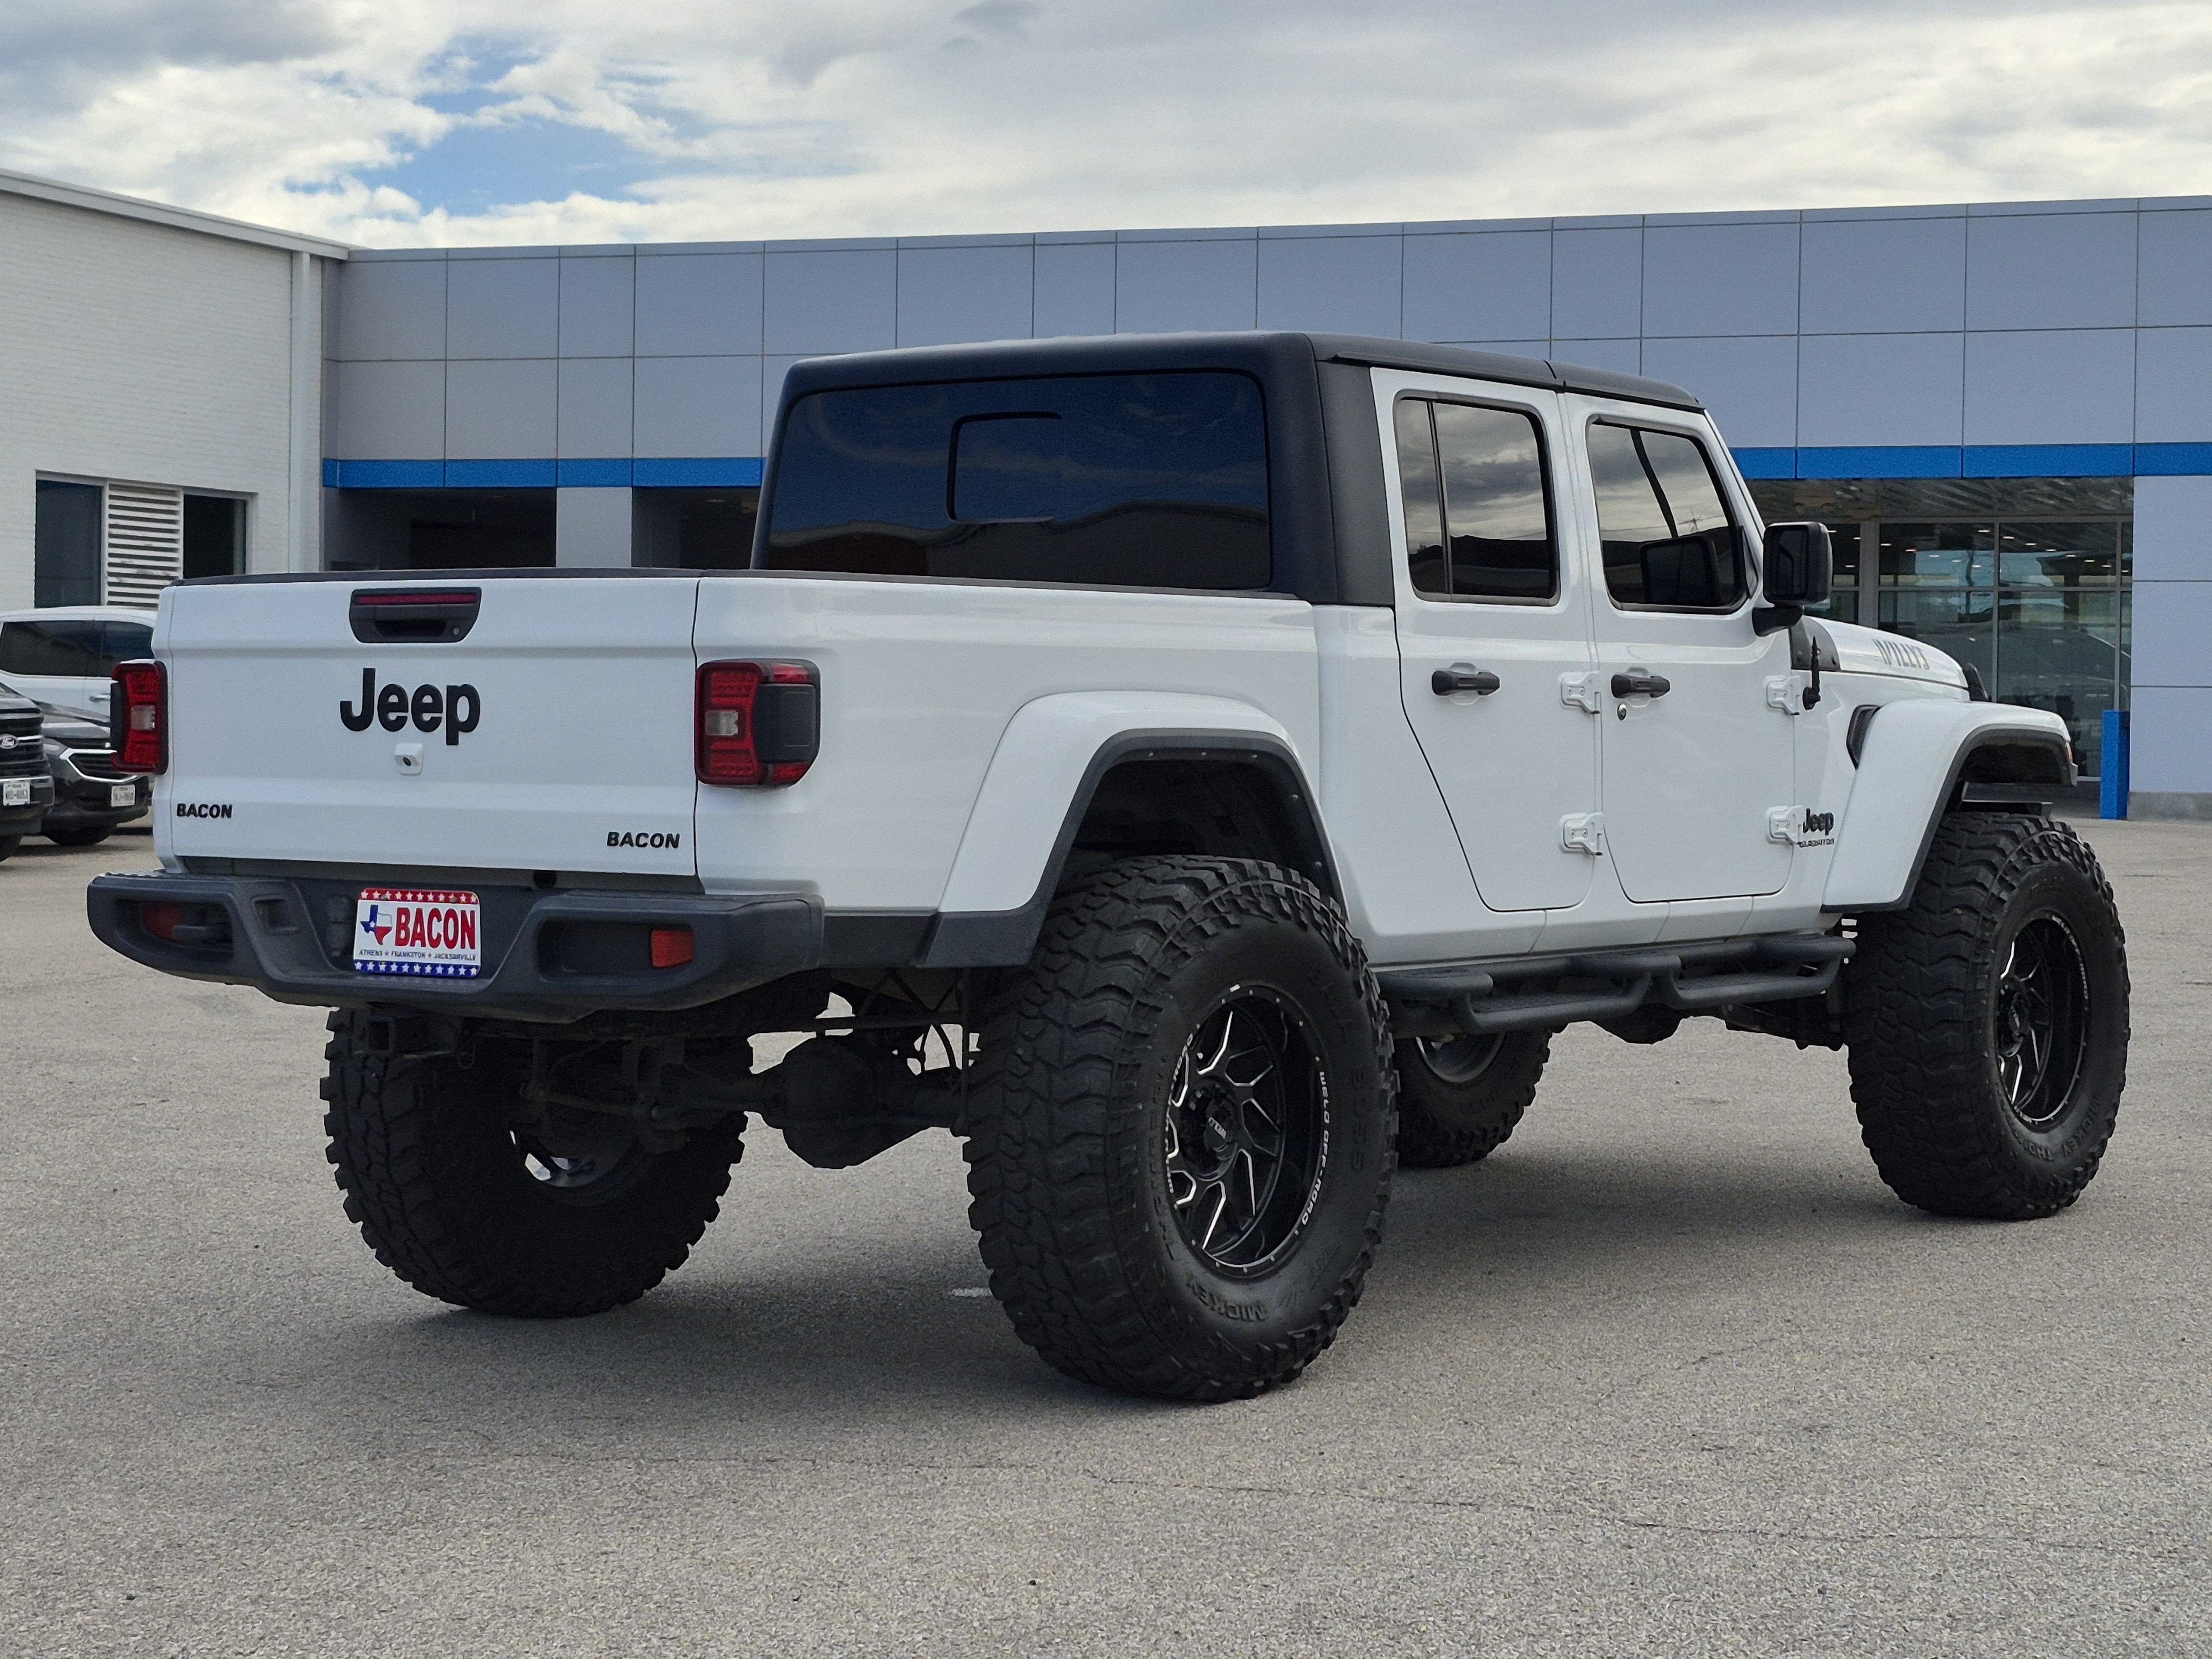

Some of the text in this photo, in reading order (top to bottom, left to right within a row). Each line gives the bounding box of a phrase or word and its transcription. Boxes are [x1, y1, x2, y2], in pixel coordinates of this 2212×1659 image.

[1871, 639, 1930, 670] WILLYS
[340, 667, 480, 745] Jeep
[176, 803, 232, 818] BACON
[1803, 808, 1834, 836] Jeep
[607, 832, 680, 849] BACON
[395, 907, 476, 950] BACON
